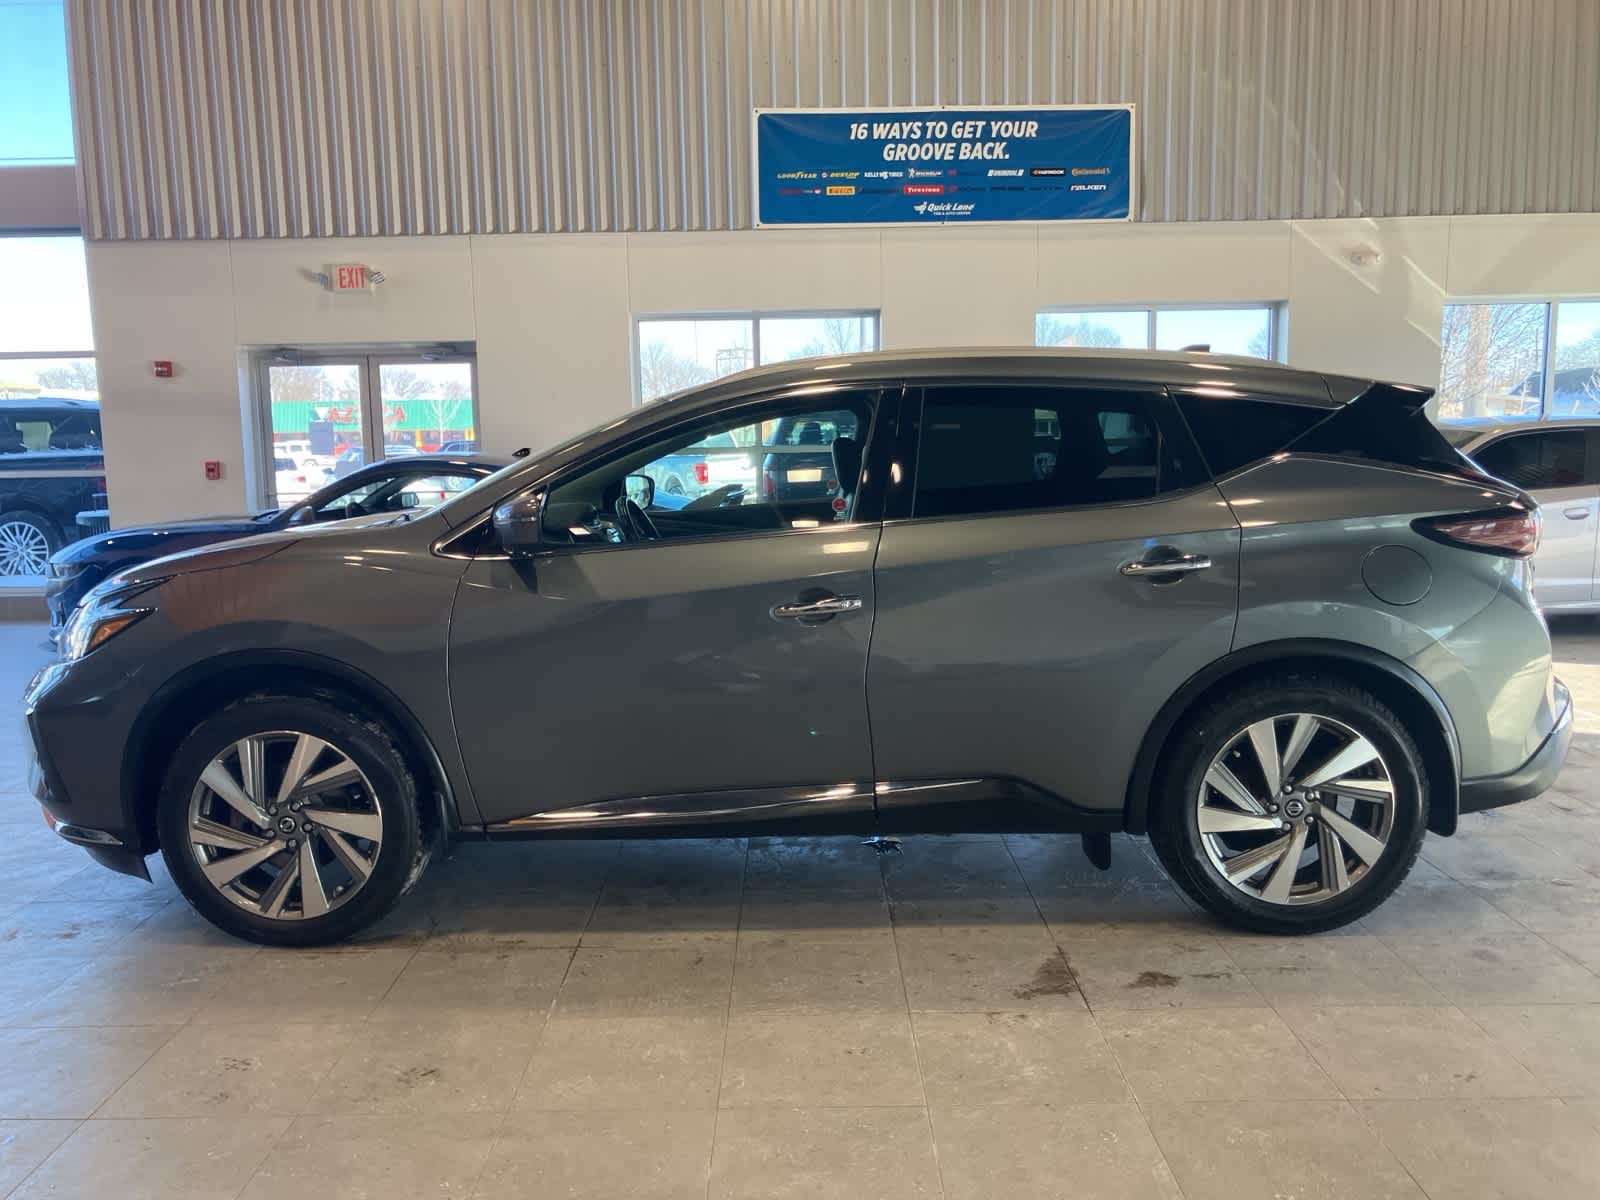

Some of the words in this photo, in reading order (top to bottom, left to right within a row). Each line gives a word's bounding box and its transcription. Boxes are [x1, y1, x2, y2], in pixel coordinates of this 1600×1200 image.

[850, 123, 868, 140] 16
[872, 122, 922, 139] WAYS
[926, 121, 948, 139] TO
[951, 121, 986, 138] GET
[990, 120, 1039, 138] YOUR
[882, 143, 955, 161] GROOVE
[959, 142, 1010, 160] BACK.
[927, 202, 952, 212] Quick
[952, 202, 976, 211] Lane
[338, 267, 366, 289] EXIT
